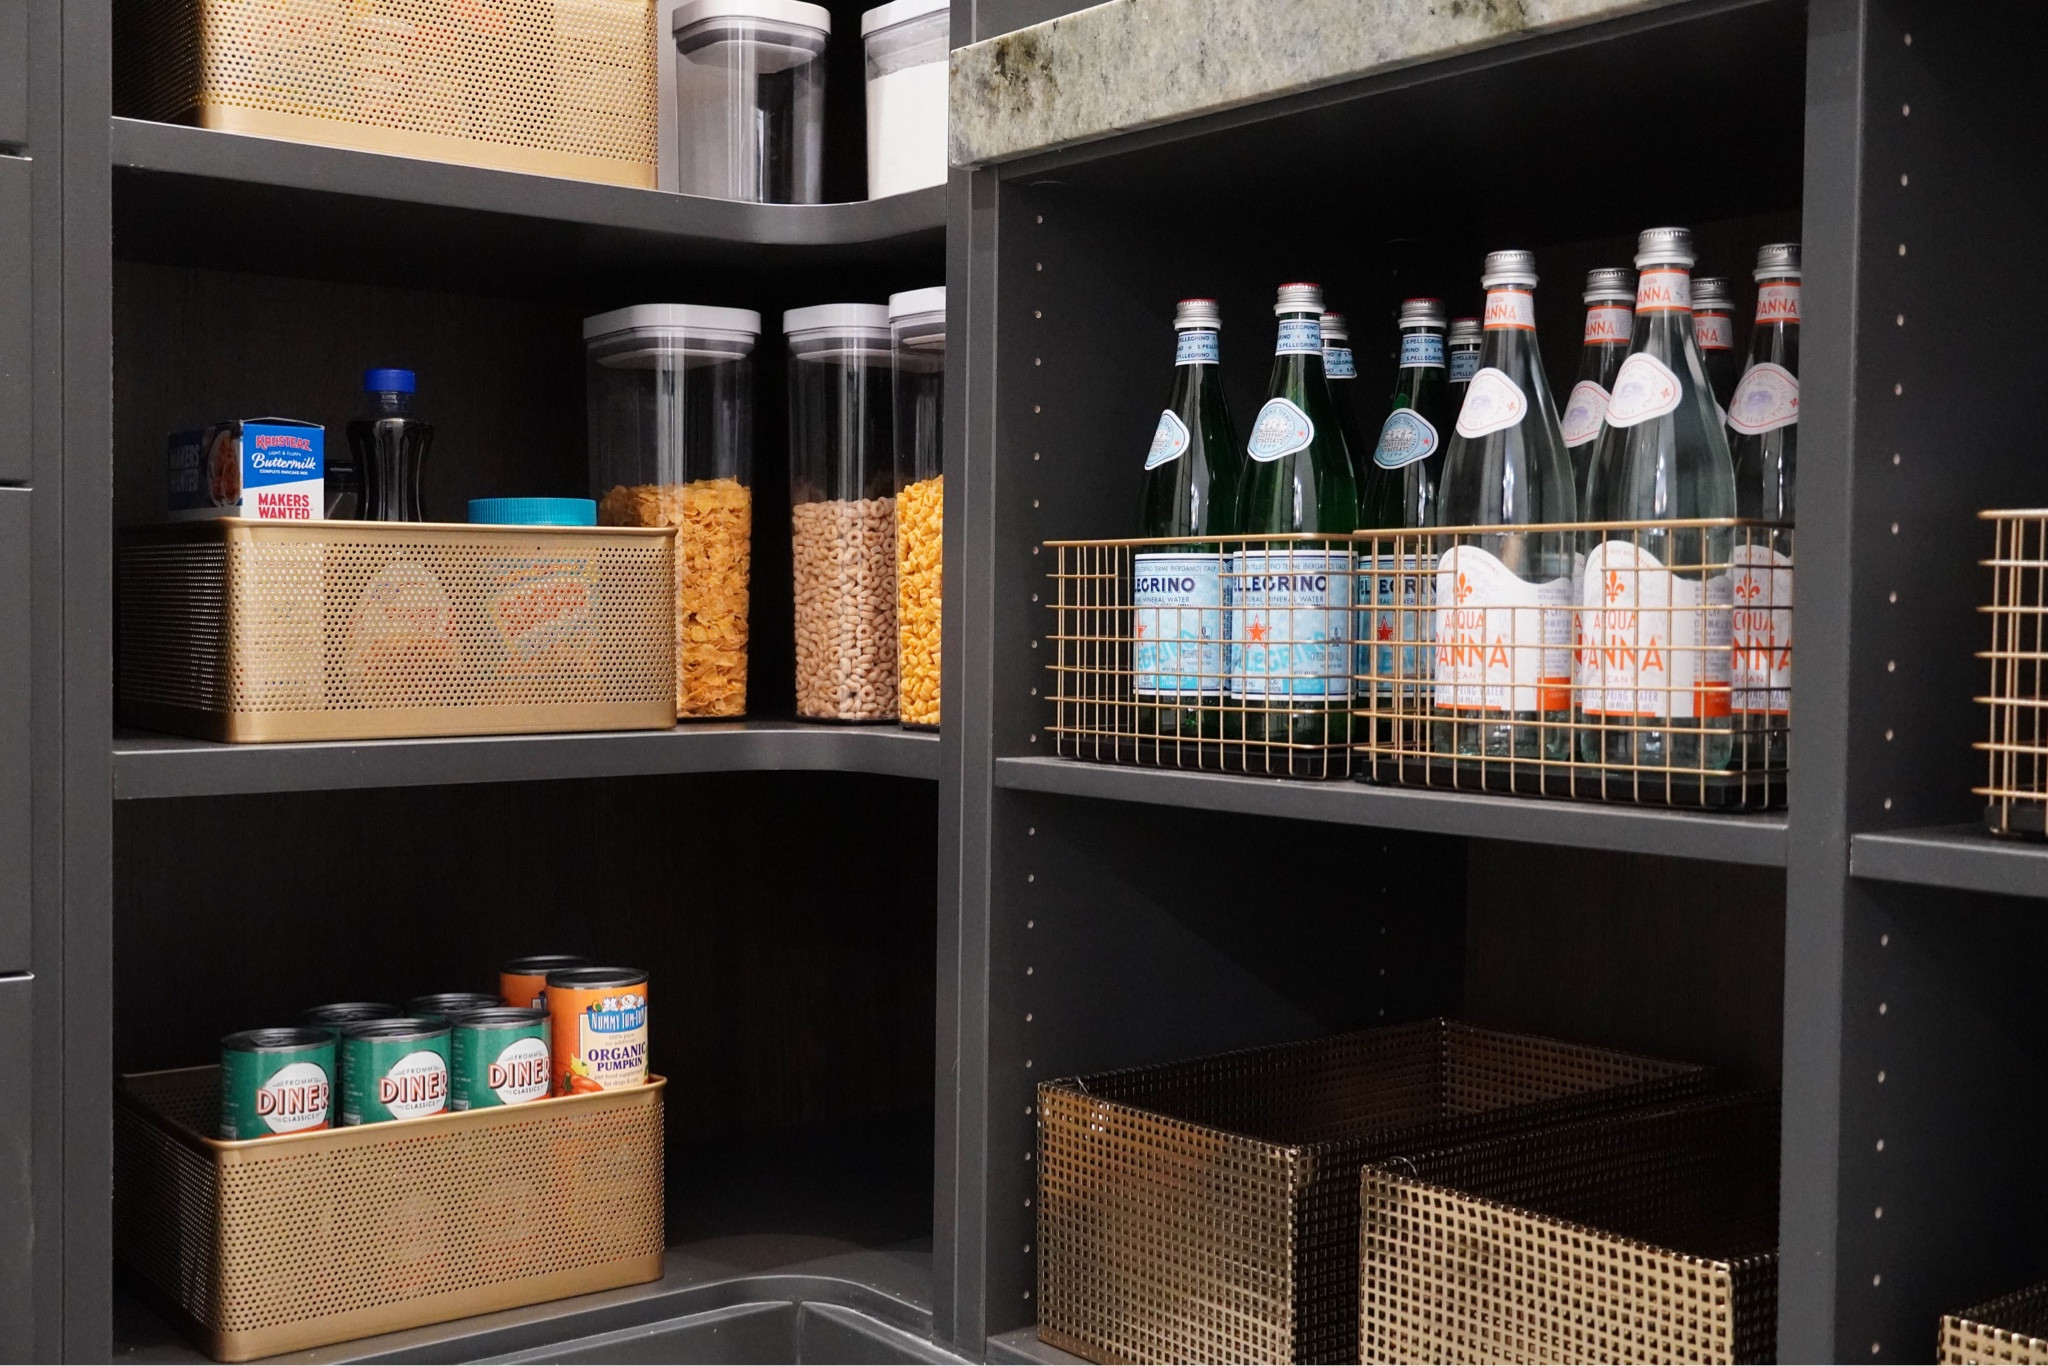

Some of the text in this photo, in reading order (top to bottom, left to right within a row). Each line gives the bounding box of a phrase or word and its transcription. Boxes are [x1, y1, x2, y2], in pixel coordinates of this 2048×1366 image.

[1637, 286, 1670, 303] ANNA
[1486, 304, 1516, 320] ANNA
[255, 434, 312, 451] KRUSTEAZ
[251, 452, 316, 470] Buttermilk
[258, 493, 309, 507] MAKERS
[258, 507, 310, 520] WANTED
[1135, 577, 1195, 592] EGRINO
[1442, 670, 1484, 680] TUCANY
[1591, 674, 1635, 683] TUCANY
[1454, 686, 1477, 696] PRING
[1603, 690, 1628, 701] PRING
[1632, 691, 1658, 702] ATER
[1735, 690, 1764, 701] SPING
[591, 1012, 620, 1030] NUMMY
[514, 1052, 538, 1060] FROMM
[588, 1042, 646, 1062] ORGANIC
[406, 1066, 433, 1074] FROMM
[597, 1056, 643, 1072] PUMPKIN
[488, 1056, 550, 1088] DINER
[379, 1071, 448, 1104] DINER
[512, 1086, 540, 1095] CLASSICS
[256, 1083, 330, 1116] DINER
[404, 1101, 436, 1110] CLASSICS
[282, 1114, 315, 1123] CLASSICS
